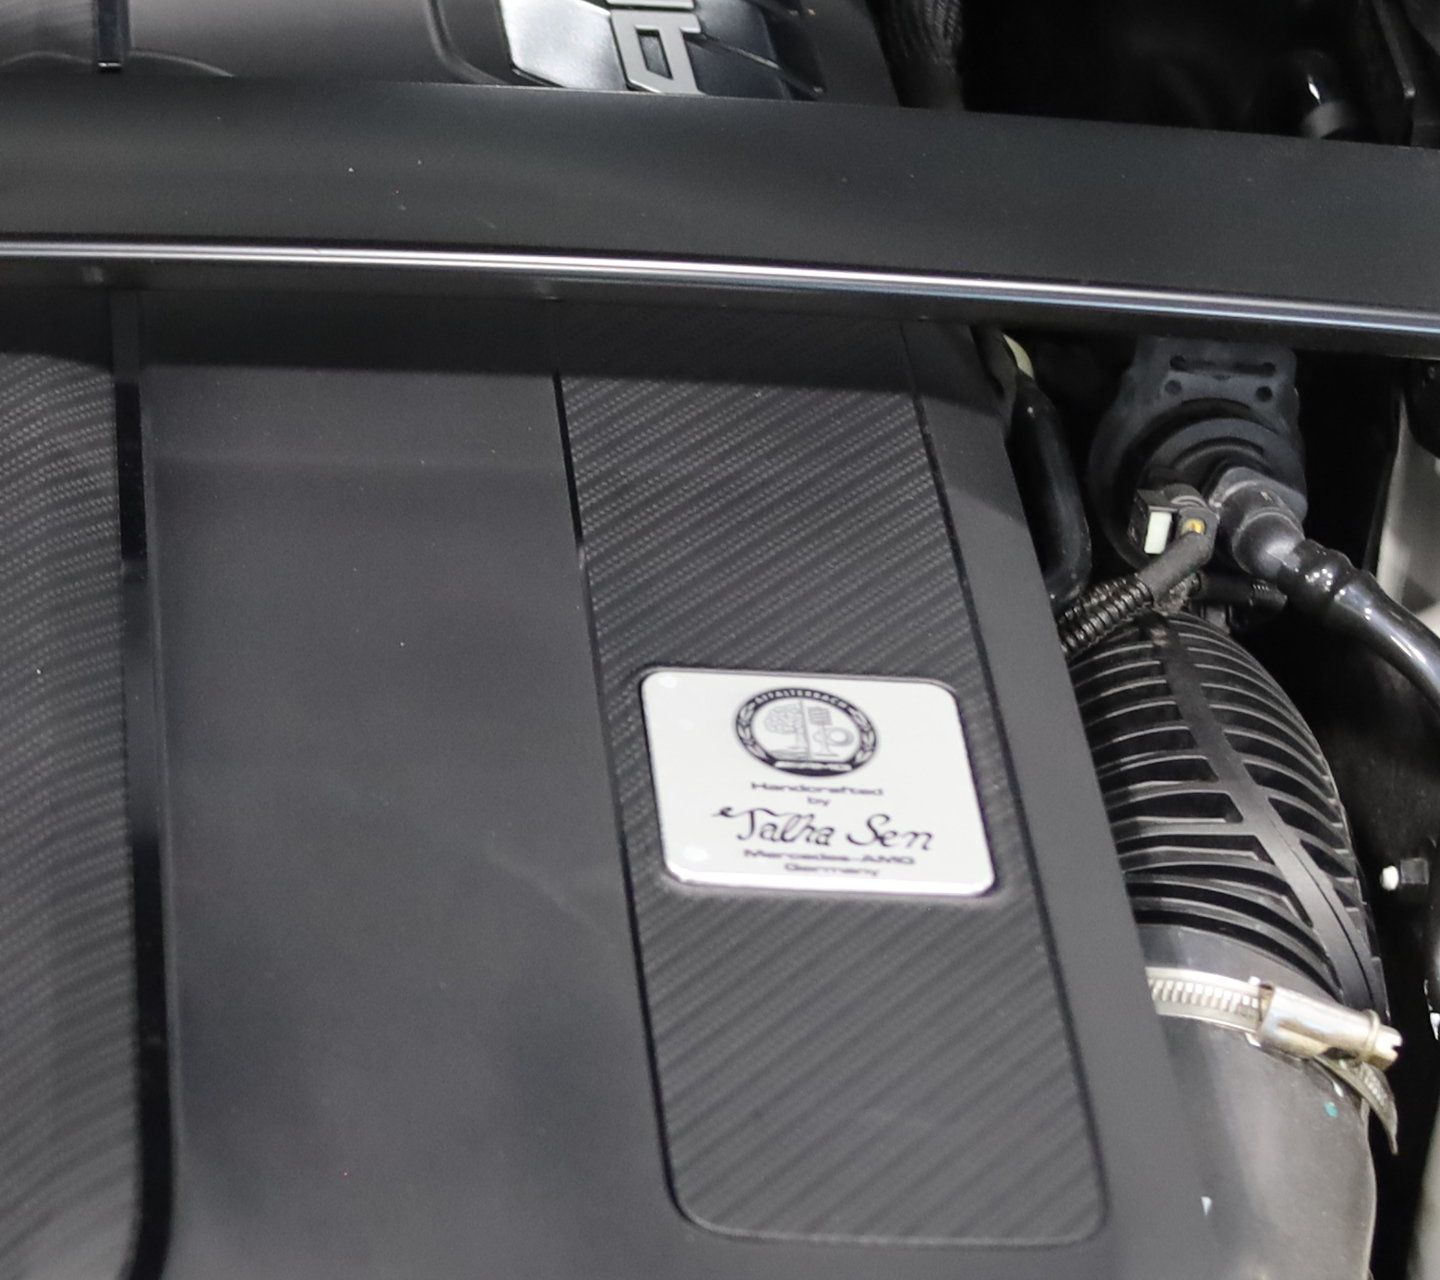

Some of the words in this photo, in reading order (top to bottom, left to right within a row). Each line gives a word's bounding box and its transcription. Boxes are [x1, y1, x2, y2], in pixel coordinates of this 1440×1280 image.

[750, 781, 884, 797] Handcrafted
[807, 796, 831, 807] by
[784, 862, 879, 877] Germany
